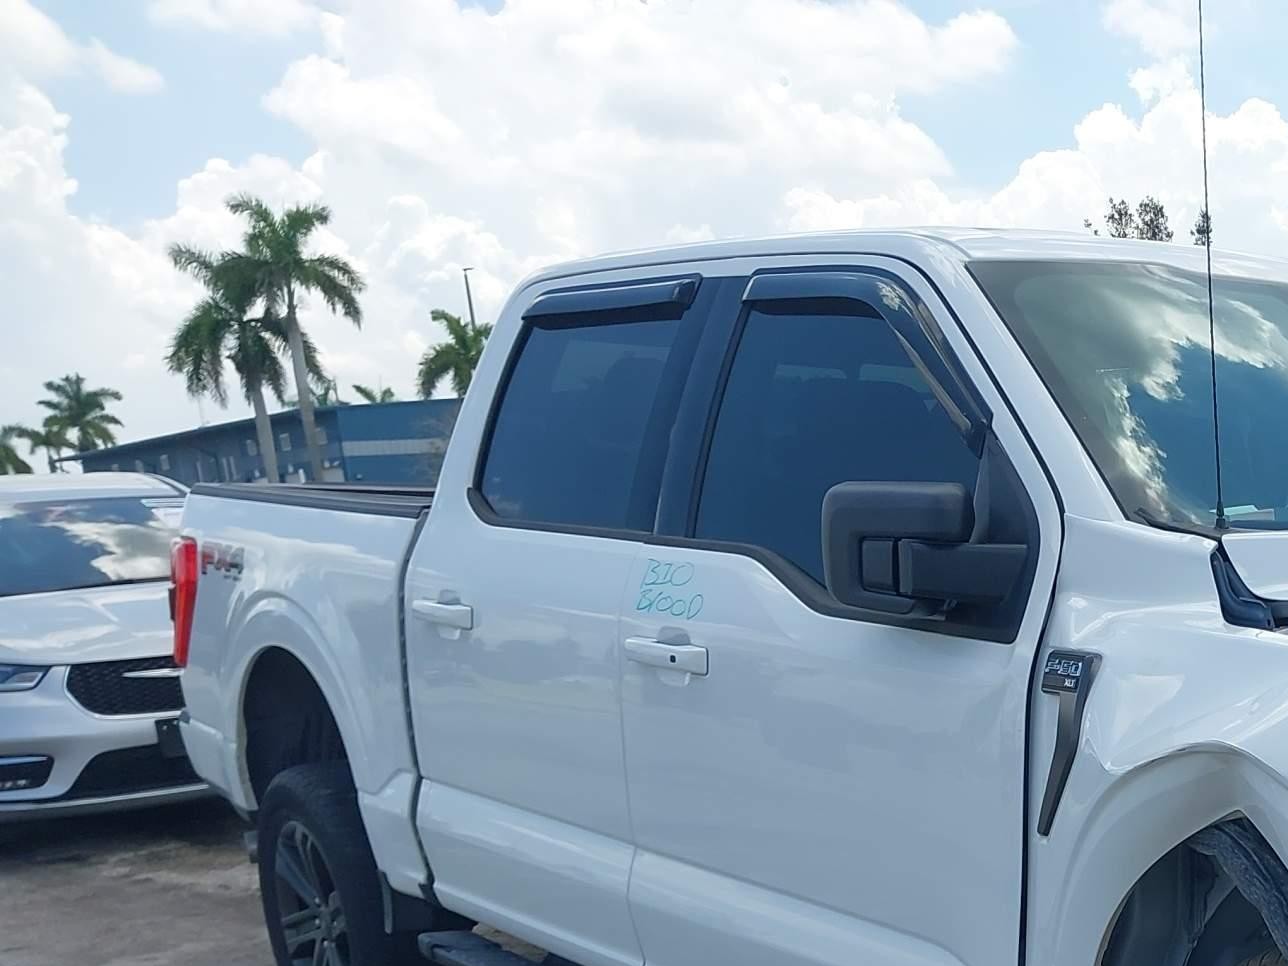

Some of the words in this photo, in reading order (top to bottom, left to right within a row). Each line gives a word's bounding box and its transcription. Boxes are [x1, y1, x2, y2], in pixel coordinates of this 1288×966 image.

[201, 542, 244, 575] FX4
[640, 558, 695, 587] BIO
[1063, 678, 1076, 687] XLT
